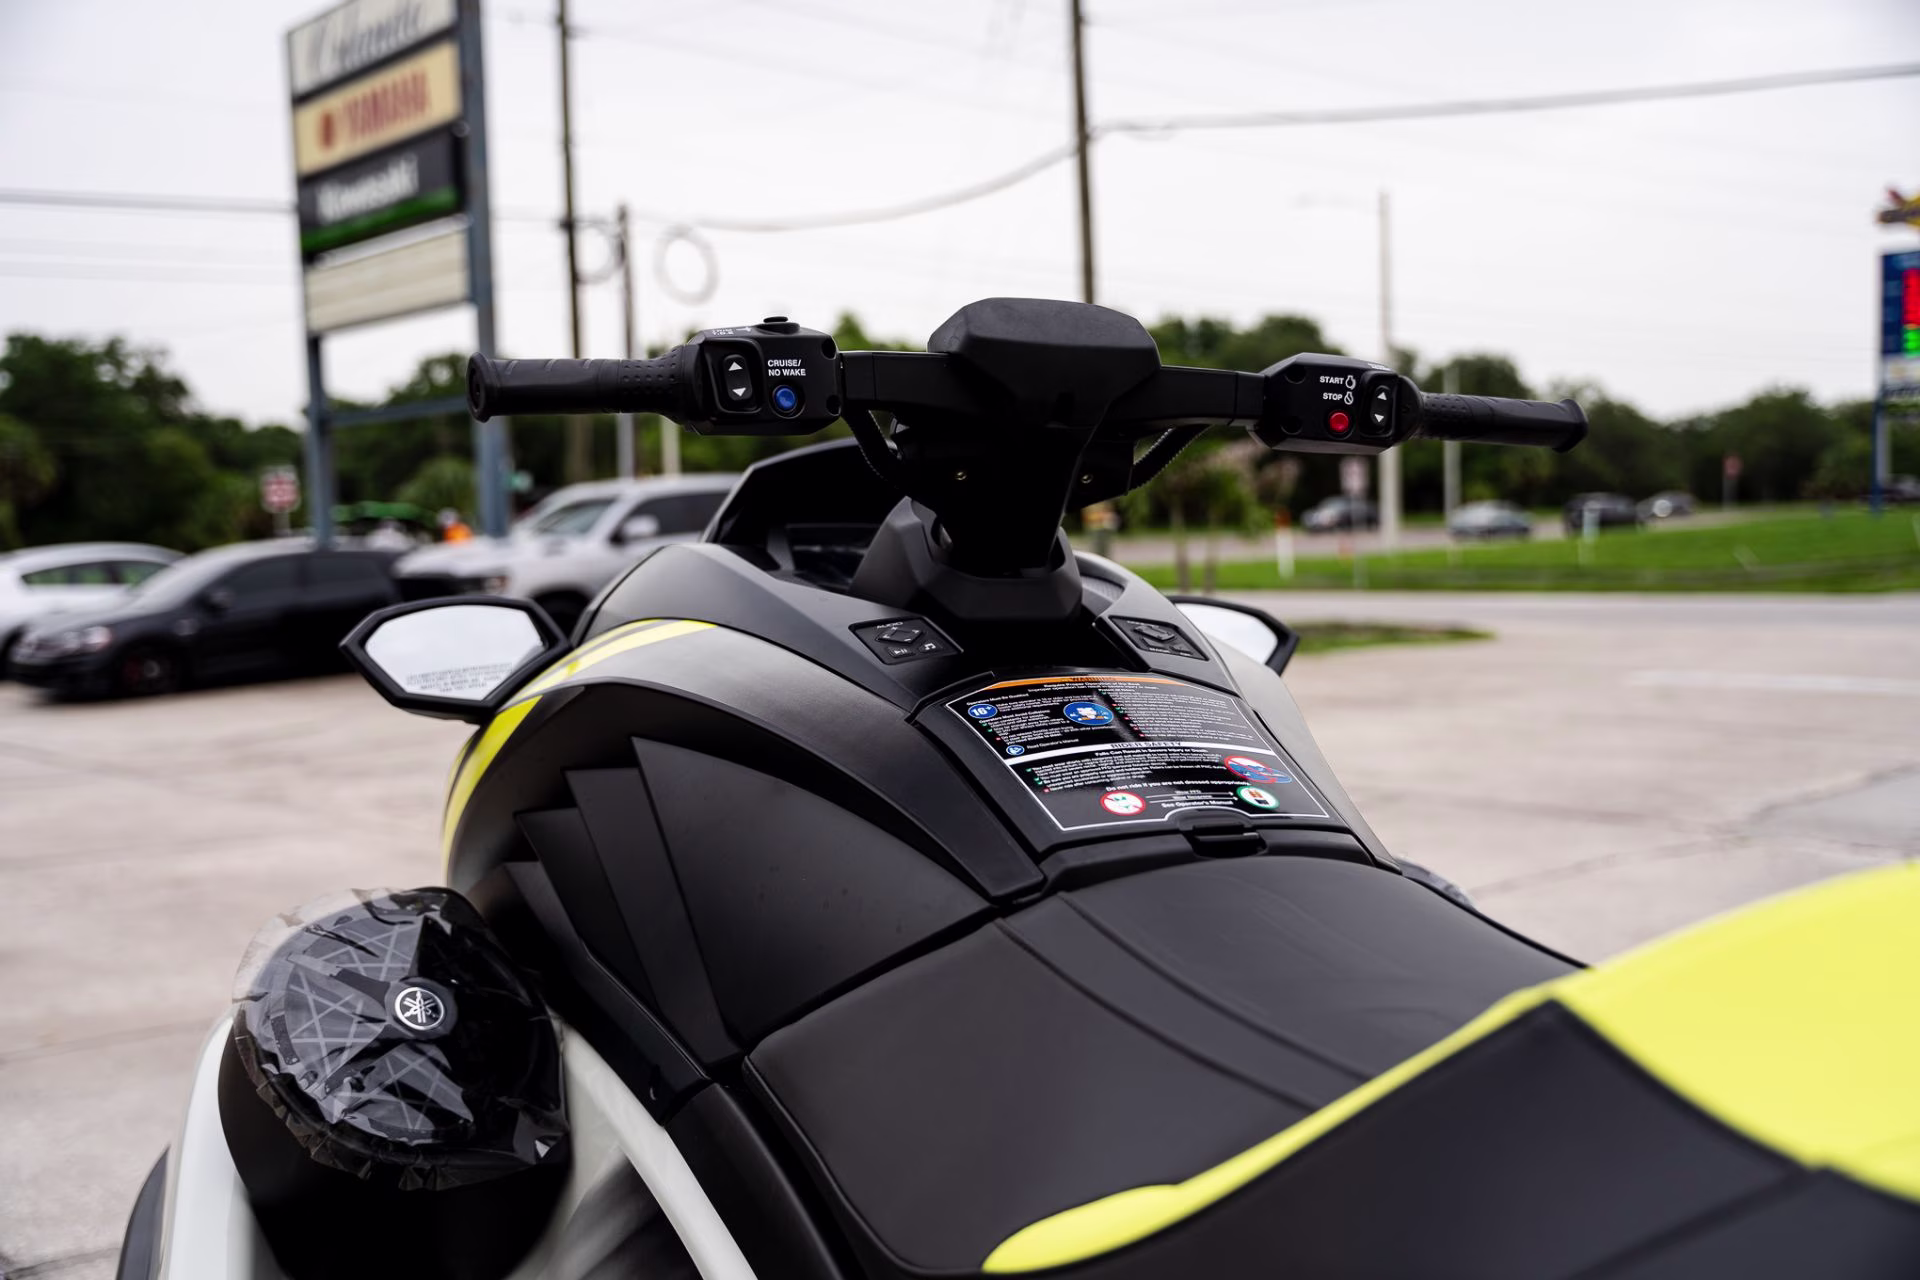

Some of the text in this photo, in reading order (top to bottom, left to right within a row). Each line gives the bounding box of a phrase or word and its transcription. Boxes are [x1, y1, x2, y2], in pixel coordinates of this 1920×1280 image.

[767, 359, 802, 367] CRUISE/
[768, 368, 806, 376] NO WAKE
[1320, 376, 1344, 385] START
[1322, 392, 1343, 401] STOP
